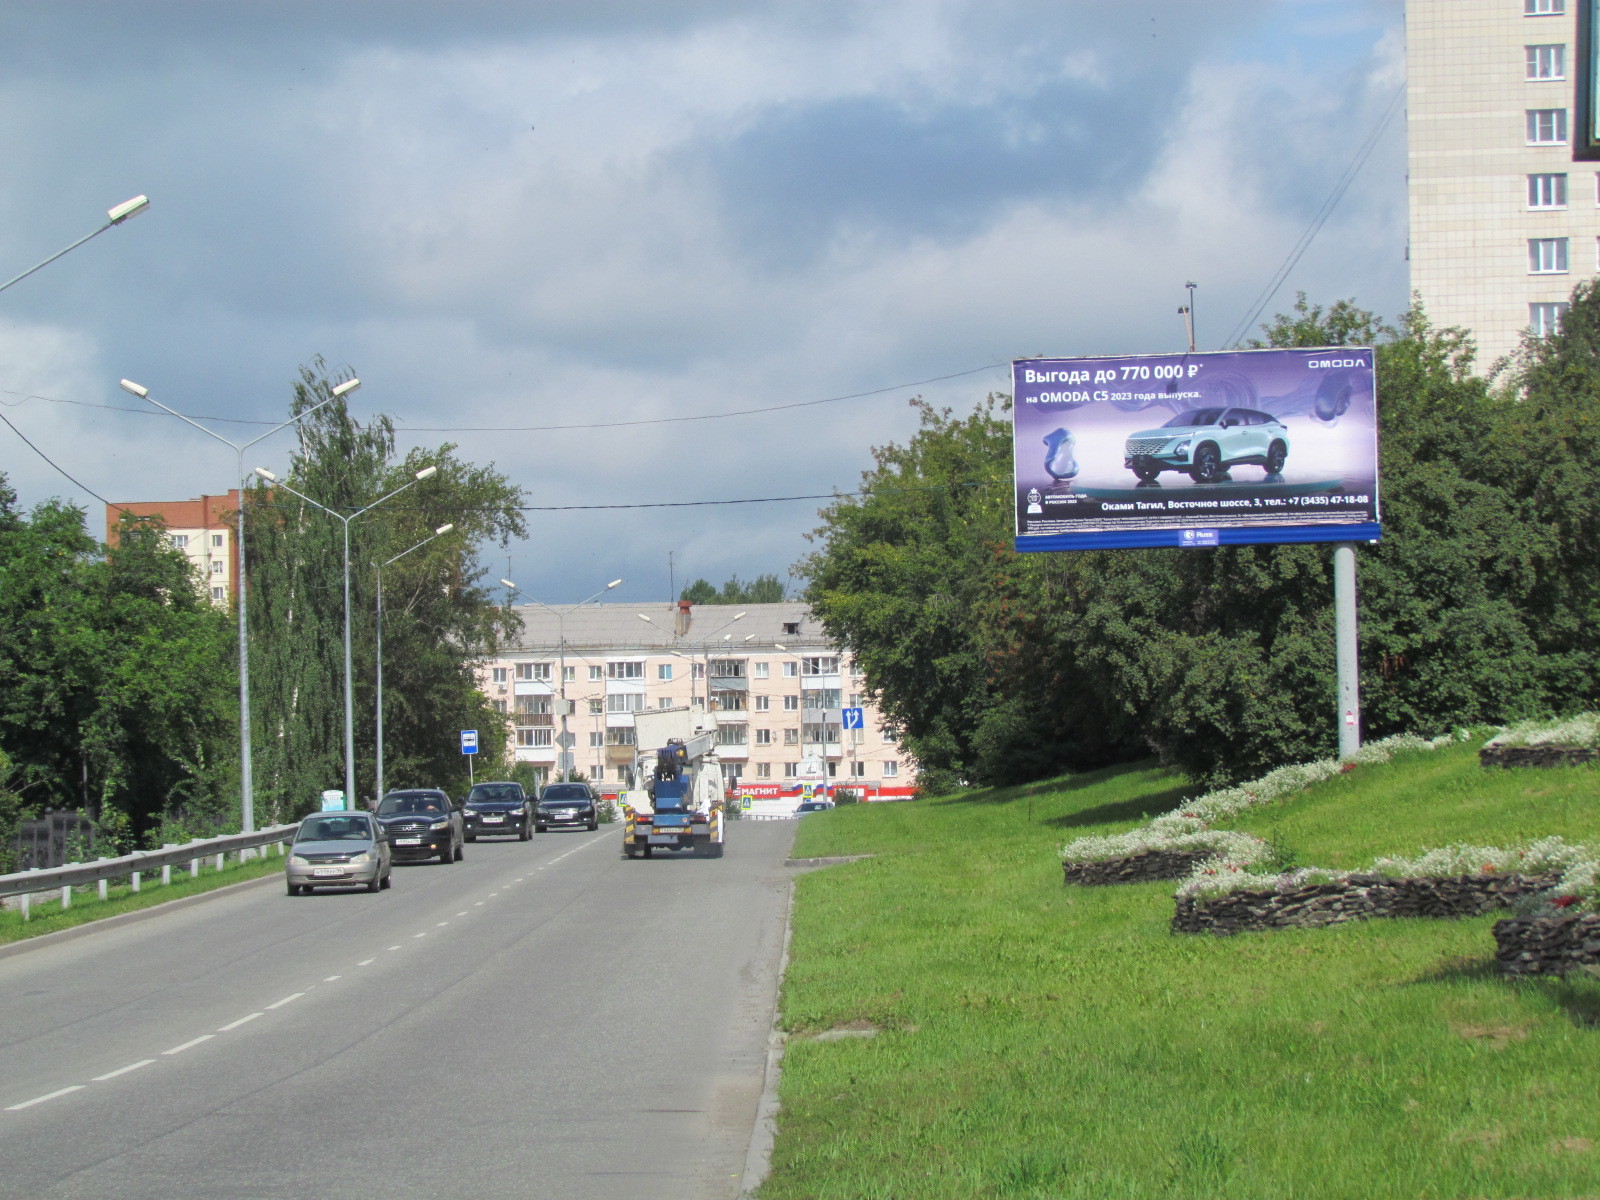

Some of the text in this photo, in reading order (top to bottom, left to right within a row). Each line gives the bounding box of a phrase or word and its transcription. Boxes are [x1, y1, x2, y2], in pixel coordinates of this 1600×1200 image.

[1025, 369, 1090, 385] Выгода
[1094, 370, 1117, 384] до
[1120, 366, 1150, 380] 770
[1154, 365, 1183, 379] 000
[1026, 390, 1202, 403] на OMODA C5 2023 года выпуска.
[1101, 495, 1369, 511] Оками Тагил, Восточное шоссе, 3, тел.: +7 (3435) 47-18-08
[741, 787, 778, 796] МАГНИТ
